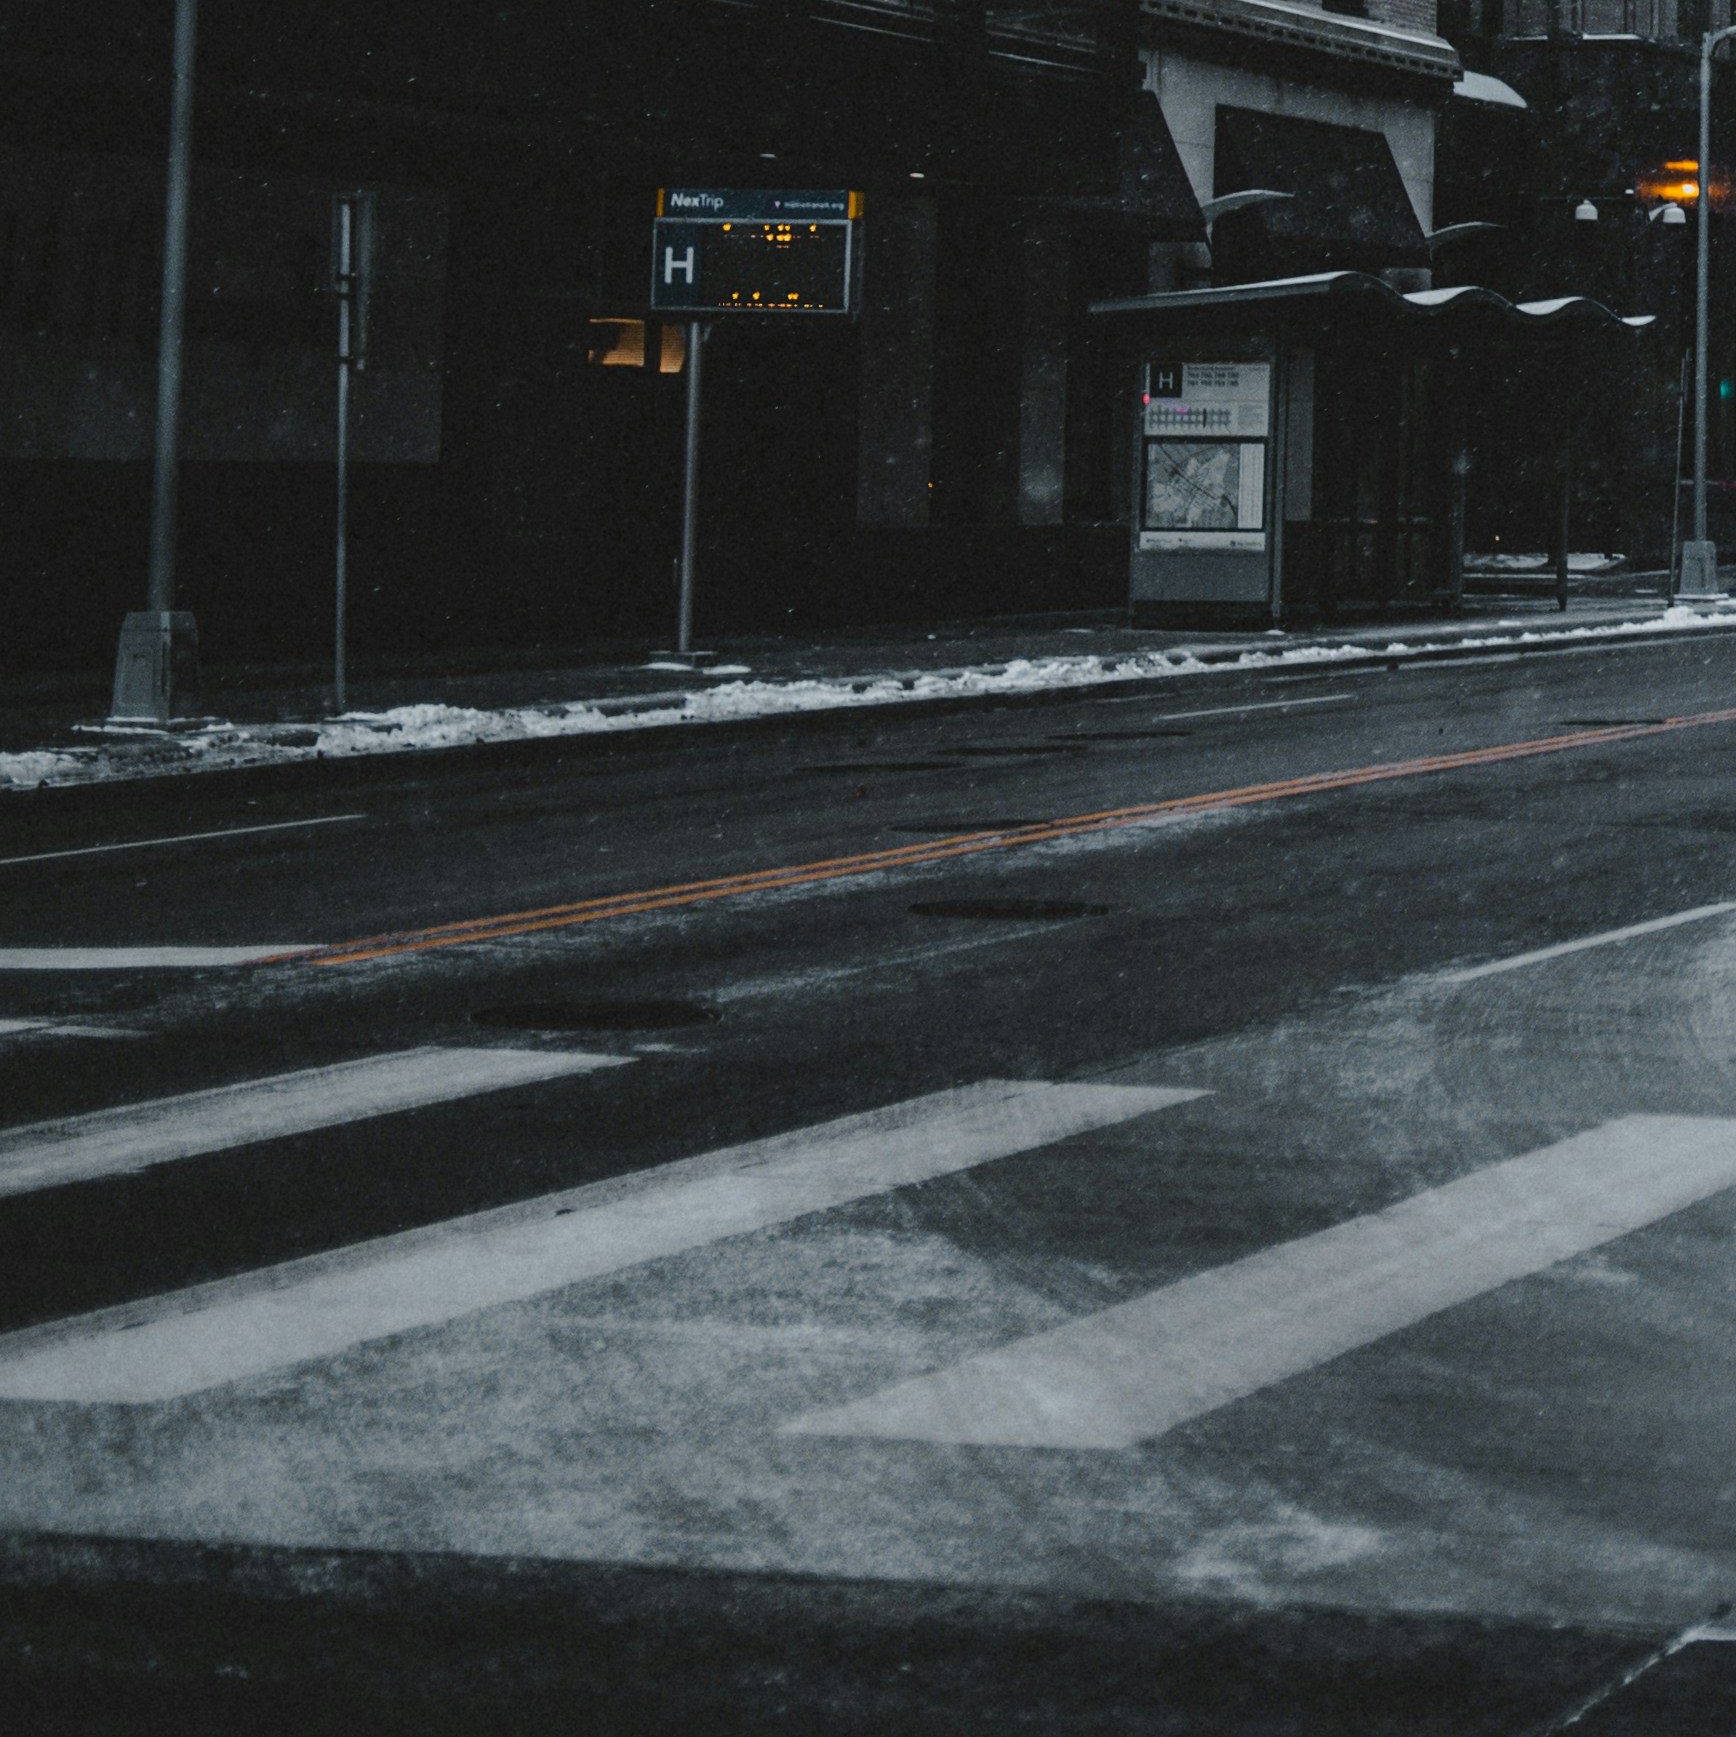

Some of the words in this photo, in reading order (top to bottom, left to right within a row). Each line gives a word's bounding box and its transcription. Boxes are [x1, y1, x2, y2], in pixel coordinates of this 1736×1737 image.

[671, 193, 724, 211] NexTrip
[664, 246, 695, 284] H
[1158, 372, 1174, 389] H
